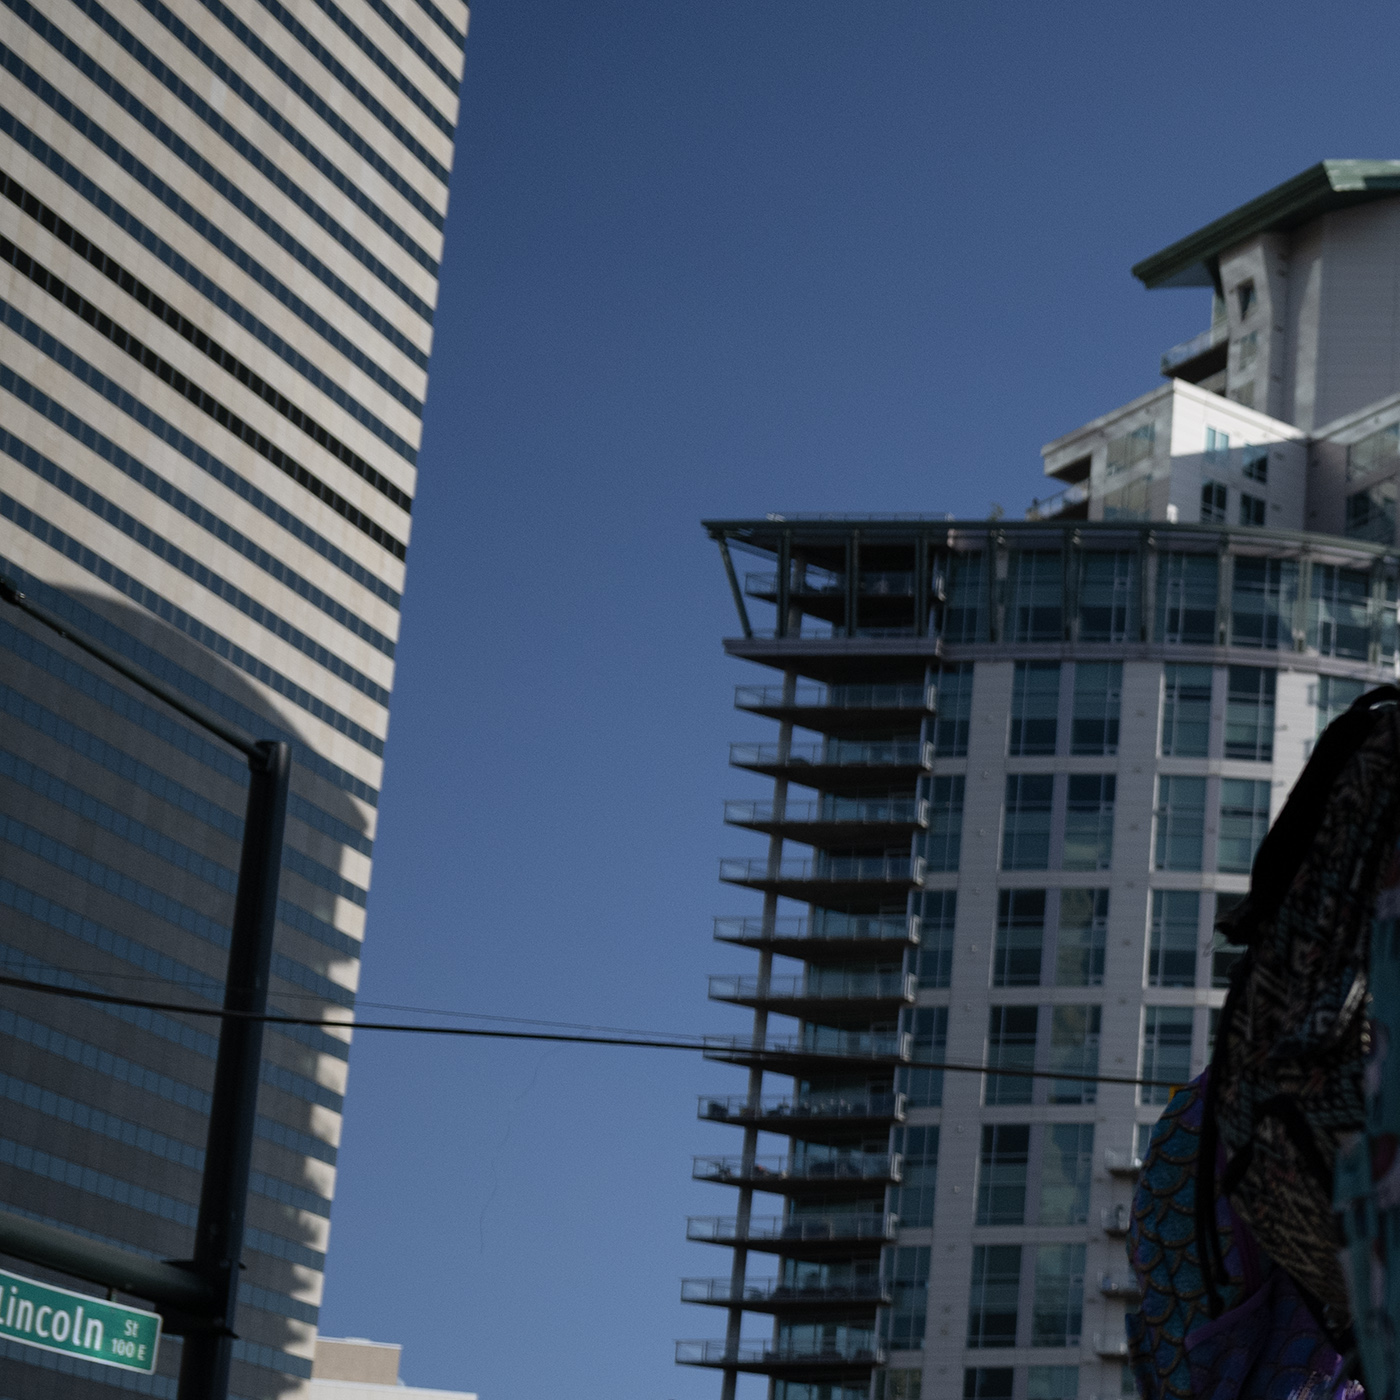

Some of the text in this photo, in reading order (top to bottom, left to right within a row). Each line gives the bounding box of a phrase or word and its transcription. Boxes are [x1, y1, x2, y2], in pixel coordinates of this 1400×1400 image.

[124, 1319, 140, 1339] St
[111, 1338, 148, 1362] 100 E
